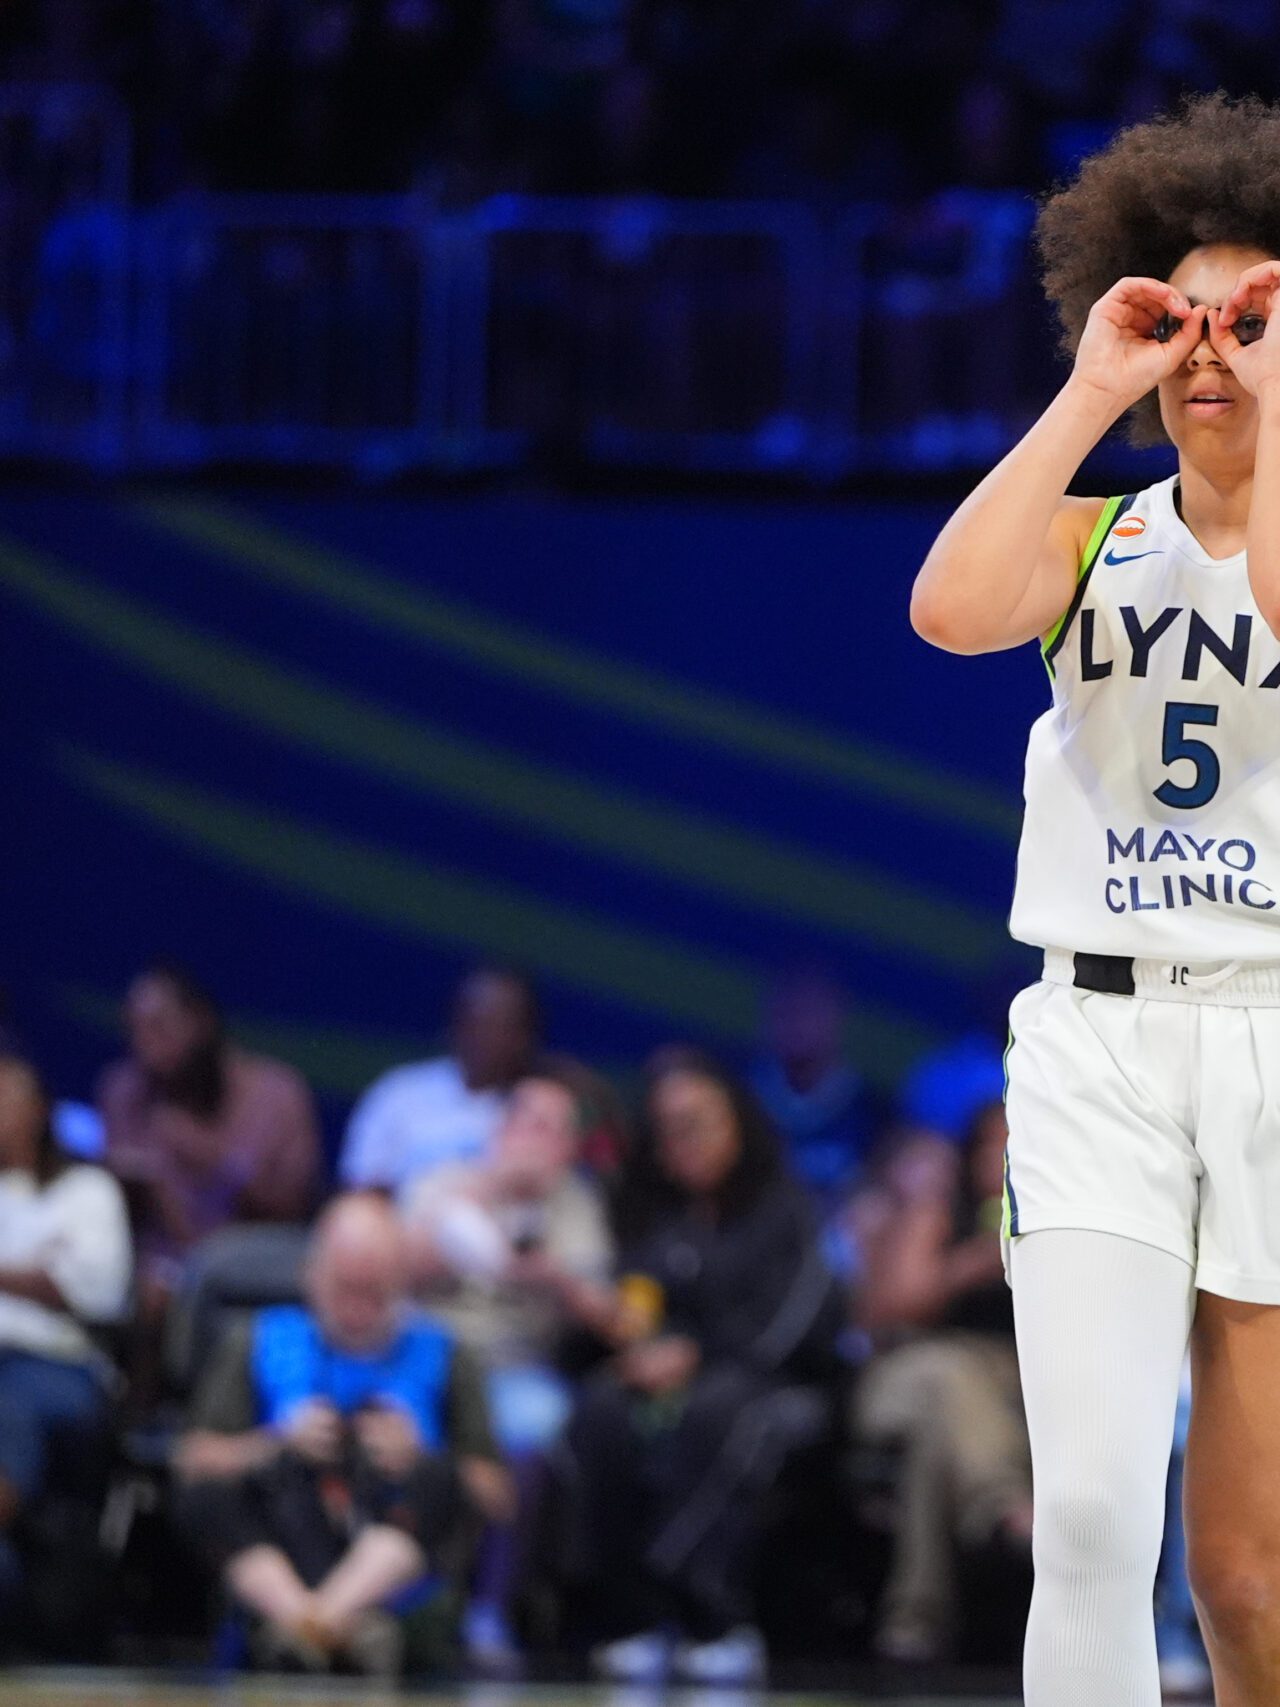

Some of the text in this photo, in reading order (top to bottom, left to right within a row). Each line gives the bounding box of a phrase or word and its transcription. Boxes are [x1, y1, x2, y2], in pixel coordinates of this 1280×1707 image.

[1152, 701, 1220, 810] 5
[1106, 827, 1256, 872] MAYO
[1105, 873, 1277, 914] CLINIC
